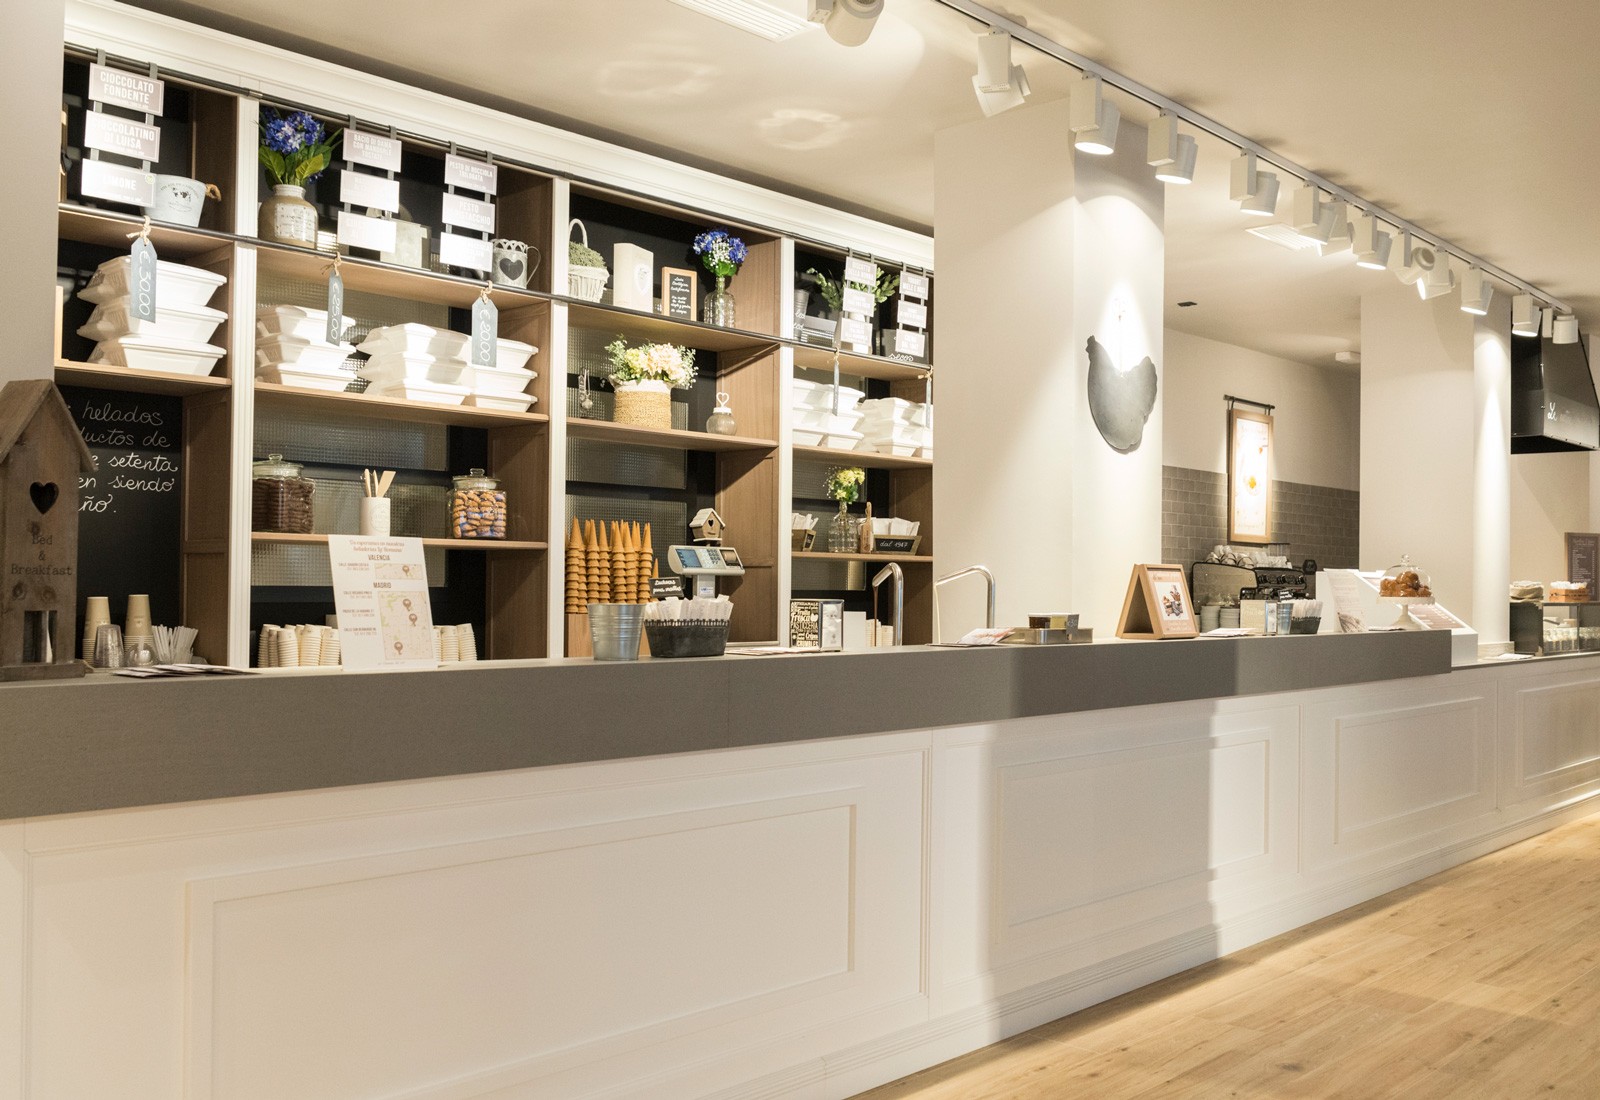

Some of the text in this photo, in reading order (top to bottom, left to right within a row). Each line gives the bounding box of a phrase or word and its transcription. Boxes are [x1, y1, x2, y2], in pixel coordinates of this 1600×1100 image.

[100, 71, 154, 94] CIOCCOLATO
[104, 83, 150, 104] FONDENTE
[116, 134, 142, 150] LUISA
[103, 174, 137, 191] LIMONE
[459, 201, 479, 213] PESTO
[139, 250, 150, 264] €
[330, 281, 340, 340] € 25.00
[479, 308, 491, 362] € 20.00
[82, 400, 163, 426] helados
[142, 431, 170, 448] de
[108, 452, 178, 472] setenta
[108, 475, 174, 492] siendo
[78, 494, 116, 513] ño.
[38, 550, 46, 561] &
[11, 564, 72, 576] Breakfast
